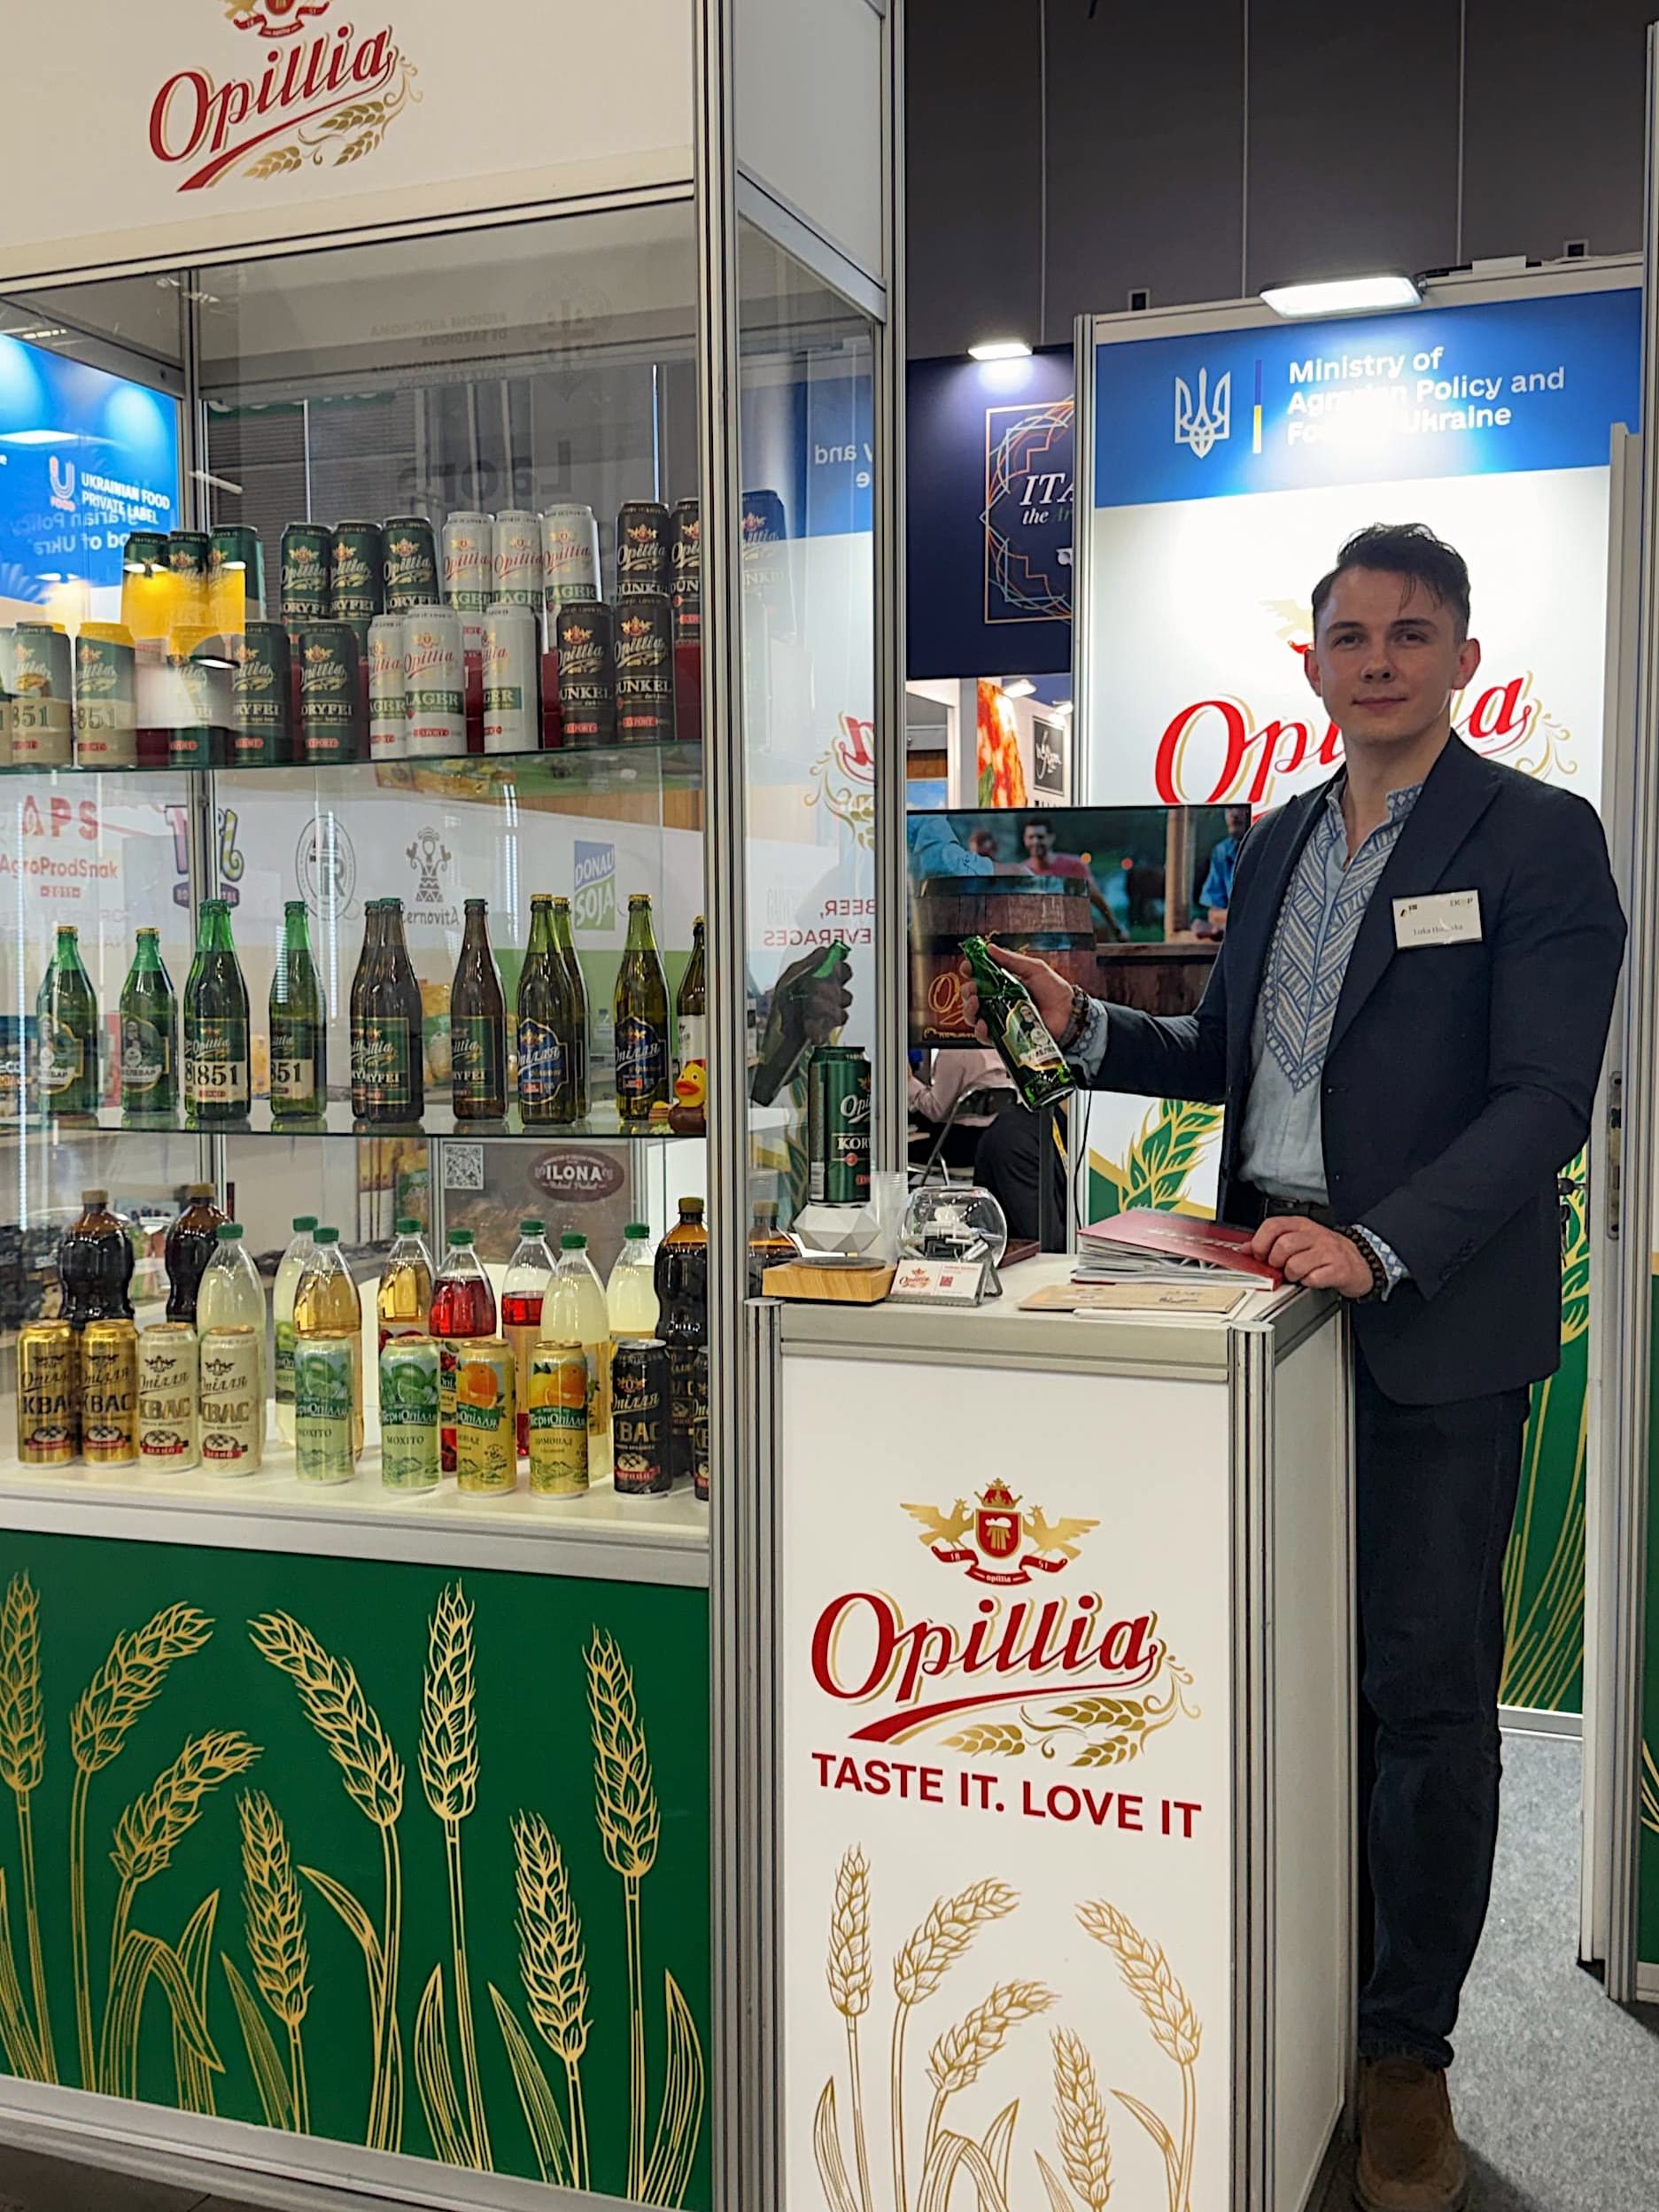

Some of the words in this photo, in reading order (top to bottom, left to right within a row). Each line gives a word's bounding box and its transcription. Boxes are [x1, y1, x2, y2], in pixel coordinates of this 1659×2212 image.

[149, 25, 399, 167] Opillia
[1289, 353, 1405, 384] Ministry
[1413, 346, 1444, 372] of
[1417, 376, 1502, 401] Policy
[1511, 367, 1564, 394] and
[81, 471, 141, 502] UKRAINIAN
[142, 488, 171, 511] FOOD
[81, 492, 126, 516] PRIVATE
[127, 504, 159, 525] LABEL
[1022, 508, 1049, 525] the
[542, 545, 592, 573] Opillia
[617, 541, 666, 569] Opillia
[671, 539, 701, 567] Opil
[671, 578, 701, 594] DUN
[404, 648, 455, 674] Opillia
[614, 633, 666, 663] Opillia
[369, 699, 406, 712] AGER
[406, 691, 459, 707] LAGER
[484, 688, 515, 703] GER
[559, 686, 613, 701] UNKEL
[234, 703, 279, 717] RYFEI
[301, 703, 353, 717] ORYFEI
[1154, 678, 1532, 804] Opia
[21, 794, 99, 842] APS
[0, 853, 119, 880] AgroProdSnak
[575, 846, 615, 889] DONAU
[404, 905, 461, 926] ernovitA
[576, 882, 615, 927] SOJA
[192, 1064, 238, 1086] 1851
[841, 1093, 872, 1118] Opil
[546, 1164, 603, 1182] ILONA
[22, 1395, 71, 1415] КВА
[616, 1421, 659, 1443] ВАС
[985, 1573, 1012, 1584] opillia
[810, 1591, 1159, 1704] Opillia
[810, 1750, 944, 1804] TASTE
[959, 1771, 1006, 1812] IT.
[1021, 1779, 1144, 1832] LOVE
[1160, 1799, 1203, 1839] IT
